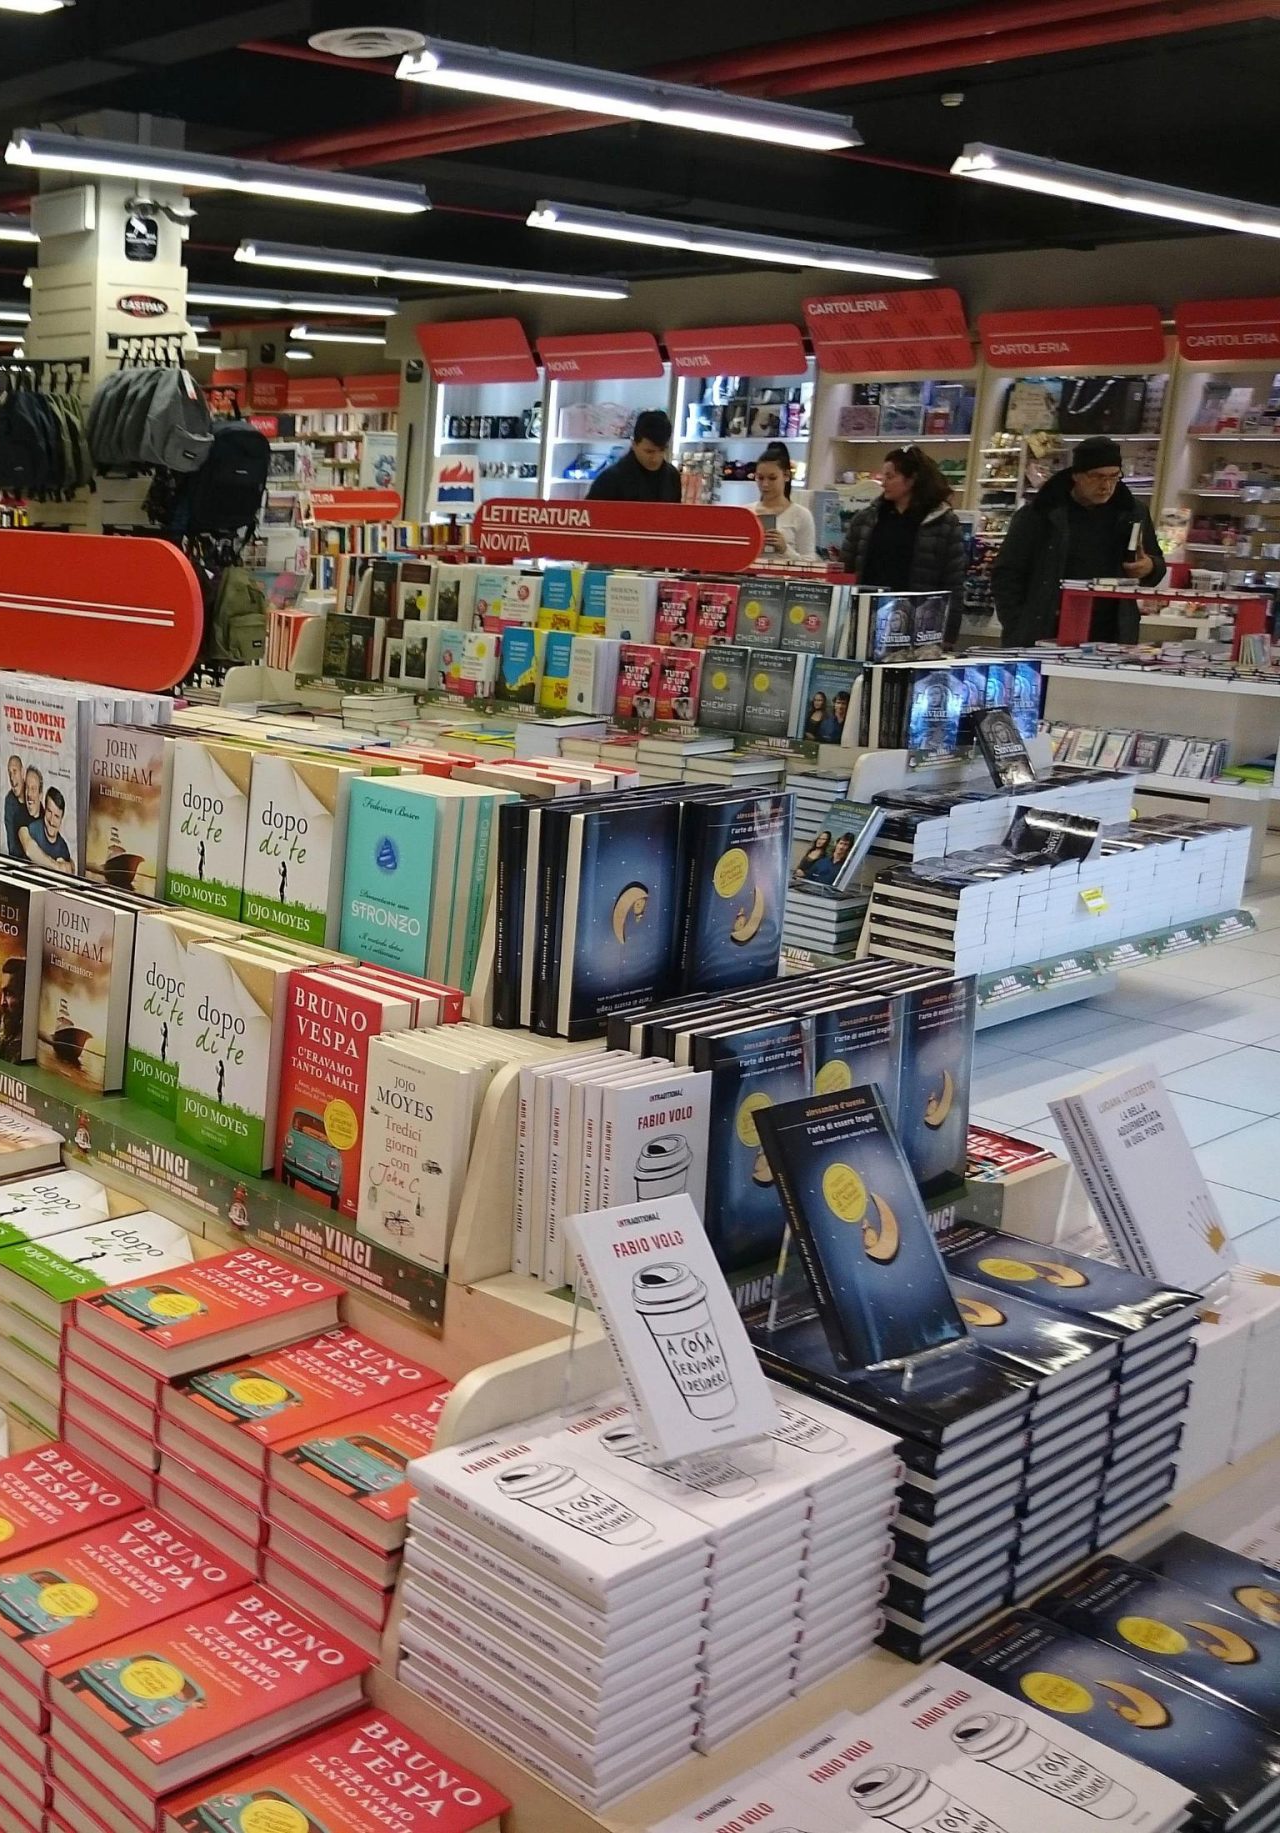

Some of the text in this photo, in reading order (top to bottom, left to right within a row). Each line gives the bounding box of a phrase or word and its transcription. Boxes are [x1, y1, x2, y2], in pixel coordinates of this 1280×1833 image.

[120, 299, 166, 313] EASTPAK
[807, 299, 888, 316] CARTOLERIA
[990, 341, 1070, 357] CARTOLERIA
[1186, 332, 1278, 348] CARTOLERIA
[434, 364, 464, 379] NOVITÀ
[546, 358, 580, 373] NOVITÀ
[676, 354, 711, 369] NOVITÀ
[481, 504, 591, 528] LETTERATURA
[479, 531, 531, 553] NOVITÀ
[789, 585, 829, 594] STEPHENIE
[661, 601, 687, 612] TUTTA
[662, 609, 683, 618] D'UN
[701, 604, 727, 614] TUTTA
[702, 611, 722, 621] D'UN
[659, 615, 685, 625] FIATO
[699, 617, 726, 628] FIATO
[735, 633, 776, 644] CHEMIST
[781, 638, 822, 649] CHEMIST
[879, 633, 911, 643] Saviano
[916, 632, 943, 643] Saviano
[624, 664, 650, 675] TUTTA
[664, 669, 690, 680] TUTTA
[758, 660, 783, 668] MEYER
[622, 678, 648, 689] FIATO
[625, 672, 645, 681] D'UN
[663, 682, 689, 693] FIATO
[666, 677, 686, 686] D'UN
[701, 700, 738, 711] CHEMIST
[745, 705, 787, 717] CHEMIST
[4, 706, 66, 729] TRE UOMINI
[13, 723, 36, 738] UNA
[36, 728, 63, 744] VITA
[105, 738, 138, 760] JOHN
[993, 744, 1023, 755] Saviano
[92, 759, 153, 787] GRISHAM
[182, 784, 224, 821] dopo
[180, 816, 222, 843] di te
[261, 801, 308, 841] dopo
[259, 834, 307, 864] di te
[170, 879, 228, 908] JOJO MOYES
[56, 908, 91, 934] JOHN
[245, 900, 311, 932] JOJO MOYES
[351, 900, 420, 937] STRONZO
[45, 927, 105, 964] GRISHAM
[788, 949, 811, 963] VINCI
[197, 995, 247, 1040] dopo
[294, 986, 368, 1033] BRUNO
[195, 1027, 245, 1066] di te
[296, 1015, 360, 1060] VESPA
[297, 1045, 353, 1078] C'ERAVAMO
[292, 1056, 360, 1094] TANTO AMATI
[394, 1075, 416, 1093] JOJO
[376, 1086, 435, 1123] MOYES
[1128, 1102, 1146, 1118] BELLA
[184, 1097, 249, 1138] JOJO MOYES
[383, 1114, 422, 1143] Tredici
[637, 1105, 693, 1131] FABIO VOLO
[834, 1117, 855, 1129] essere
[1117, 1110, 1161, 1137] ADDORMENTATA
[1131, 1132, 1146, 1145] QUEL
[1145, 1122, 1164, 1136] POSTO
[385, 1138, 418, 1160] giorni
[151, 1144, 190, 1181] VINCI
[390, 1157, 411, 1174] con
[369, 1163, 406, 1192] John
[325, 1226, 373, 1269] VINCI
[613, 1231, 684, 1259] FABIO VOLO
[666, 1331, 714, 1358] A COSA
[672, 1355, 721, 1377] SERVONO
[688, 1371, 727, 1392] DESIDERI
[236, 1595, 345, 1666] BRUNO
[204, 1625, 281, 1681] C'ERAVAMO
[223, 1611, 310, 1675] VESPA
[184, 1623, 278, 1692] TANTO AMATI
[910, 1688, 973, 1731] FABIO VOLO
[359, 1720, 483, 1807] BRUNO
[347, 1737, 446, 1818] VESPA
